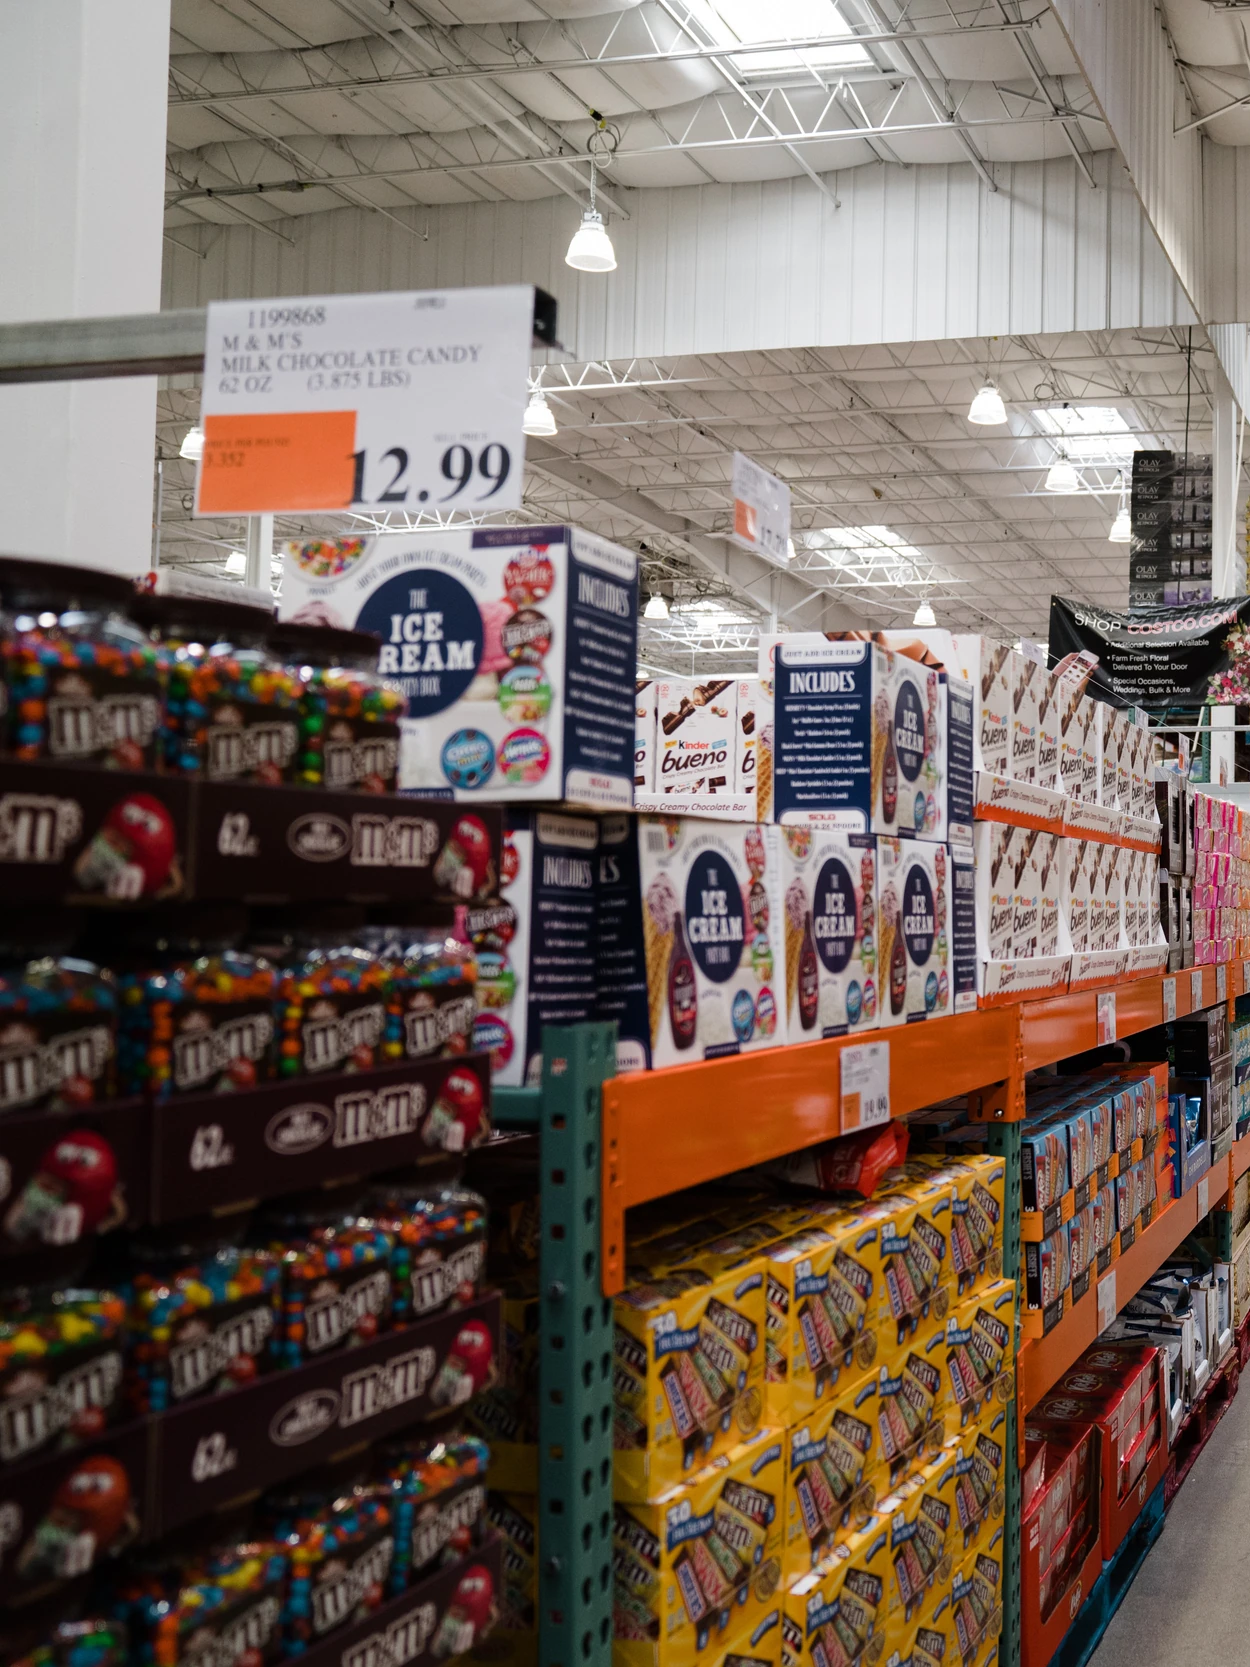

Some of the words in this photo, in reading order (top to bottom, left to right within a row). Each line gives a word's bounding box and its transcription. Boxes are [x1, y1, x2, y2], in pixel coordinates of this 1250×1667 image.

[247, 305, 327, 330] 1199868
[222, 336, 240, 351] M
[245, 335, 260, 351] &
[265, 332, 302, 351] M'S
[221, 356, 273, 374] MILK
[277, 349, 401, 371] CHOCOLATE
[407, 345, 483, 366] CANDY
[218, 377, 239, 394] 62
[244, 375, 272, 393] OZ
[306, 373, 362, 392] (3.875
[367, 370, 412, 390] LBS)
[347, 441, 512, 507] 12.99
[1139, 459, 1160, 467] OLAY
[1137, 486, 1159, 494] OLAY
[1137, 512, 1158, 520] OLAY
[1135, 565, 1158, 573] OLAY
[409, 588, 428, 609] THE
[578, 572, 630, 617] INCLUDES
[390, 612, 444, 642] ICE
[1074, 613, 1122, 633] SHOP
[1127, 610, 1238, 635] COSTCO.COM
[1178, 639, 1210, 647] Available
[377, 641, 476, 674] REAM
[1150, 654, 1169, 662] Floral
[790, 671, 855, 694] INCLUDES
[1113, 677, 1136, 686] Special
[1138, 677, 1175, 685] Occasions,
[1113, 686, 1148, 694] Weddings,
[903, 711, 918, 731] ICE
[895, 730, 924, 753] CREAM
[981, 725, 1008, 747] bueno
[1013, 739, 1035, 757] bueno
[661, 750, 727, 774] bueno
[1061, 758, 1082, 775] bueno
[659, 803, 689, 812] Creamy
[691, 802, 730, 812] Chocolate
[732, 803, 747, 811] Bar
[701, 890, 728, 916] ICE
[825, 893, 846, 915] ICE
[912, 895, 926, 914] ICE
[689, 917, 744, 944] CREAM
[815, 916, 855, 939] CREAM
[904, 916, 934, 936] CREAM
[1014, 908, 1037, 933] bueno
[1024, 1148, 1033, 1180] HERSHEY'S
[1027, 1246, 1037, 1278] HERSHEY'S
[886, 1271, 902, 1319] SNICKERS
[802, 1316, 821, 1366] SNICKERS
[665, 1375, 689, 1430] SNICKERS
